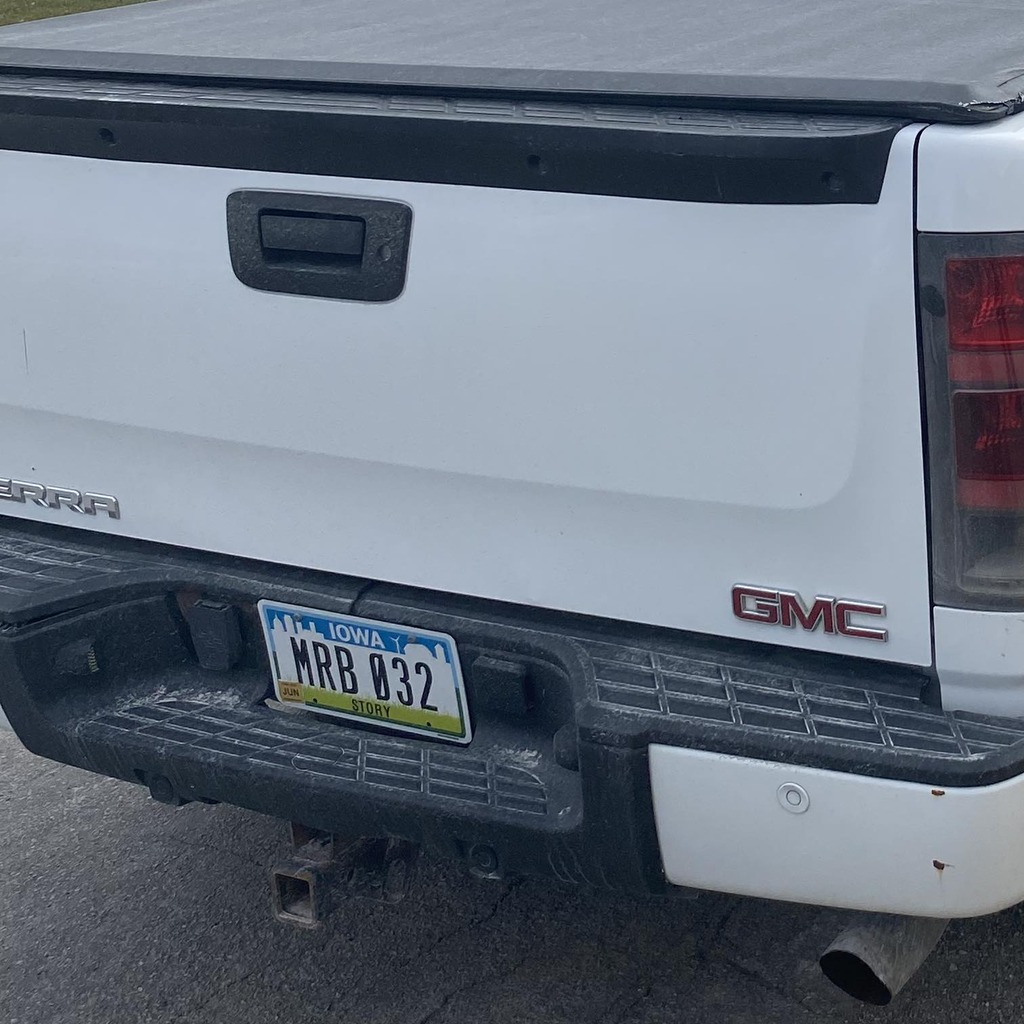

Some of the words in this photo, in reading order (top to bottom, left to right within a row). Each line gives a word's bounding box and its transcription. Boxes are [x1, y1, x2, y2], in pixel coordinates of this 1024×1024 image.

[732, 583, 889, 643] GMC
[329, 622, 386, 649] IOWA
[290, 636, 358, 695] MRB
[369, 653, 438, 712] 032
[282, 687, 300, 697] JUN
[351, 698, 391, 718] STORY
